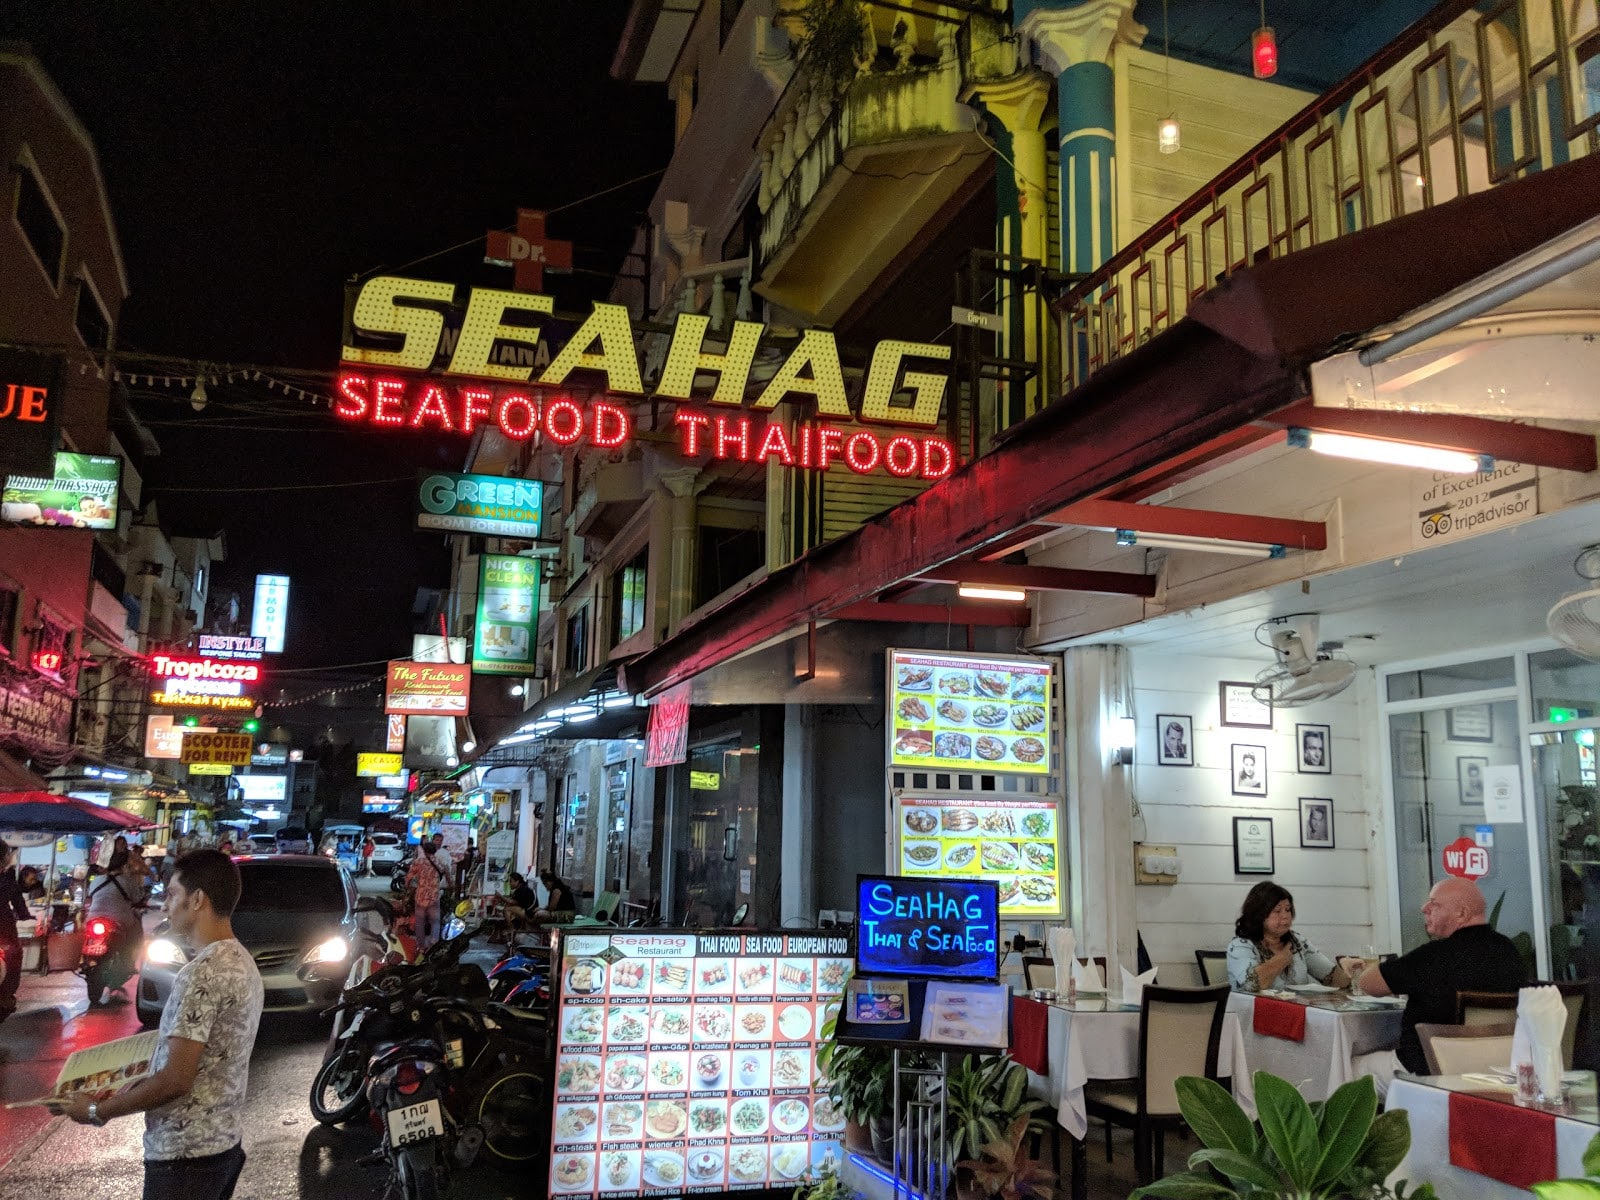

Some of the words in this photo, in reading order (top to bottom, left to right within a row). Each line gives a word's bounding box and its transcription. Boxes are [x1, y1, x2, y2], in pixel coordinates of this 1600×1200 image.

[510, 236, 546, 262] Dr.
[342, 275, 953, 427] SEAHAG
[337, 375, 629, 448] SEAFOOD
[54, 479, 117, 496] MASSAGE
[1423, 484, 1438, 501] of
[1442, 462, 1520, 496] Excellence
[420, 474, 540, 514] GREEN
[1457, 491, 1489, 510] 2012
[456, 503, 538, 521] MANSION
[1455, 499, 1529, 530] tripadvisor
[470, 520, 496, 532] FOR
[500, 523, 534, 535] RENT
[486, 559, 520, 572] NICE
[524, 562, 535, 573] &
[486, 571, 535, 585] CLEAN
[199, 635, 265, 652] INSTYLE
[153, 656, 259, 681] Tropicoza
[393, 667, 418, 681] The
[420, 668, 465, 682] Future
[183, 734, 251, 749] SCOOTER
[185, 749, 211, 762] FOR
[214, 750, 248, 763] RENT
[611, 936, 687, 947] Seahag
[700, 936, 718, 953] THAI
[720, 936, 741, 953] FOOD
[746, 937, 761, 953] SEA
[762, 937, 783, 953] FOOD
[788, 937, 827, 954] EUROPEAN
[828, 938, 848, 954] FOOD
[908, 929, 923, 951] &
[637, 946, 682, 955] Restaurant
[611, 996, 647, 1004] sh-cake
[398, 1126, 436, 1144] 6508
[690, 1138, 707, 1146] Phad
